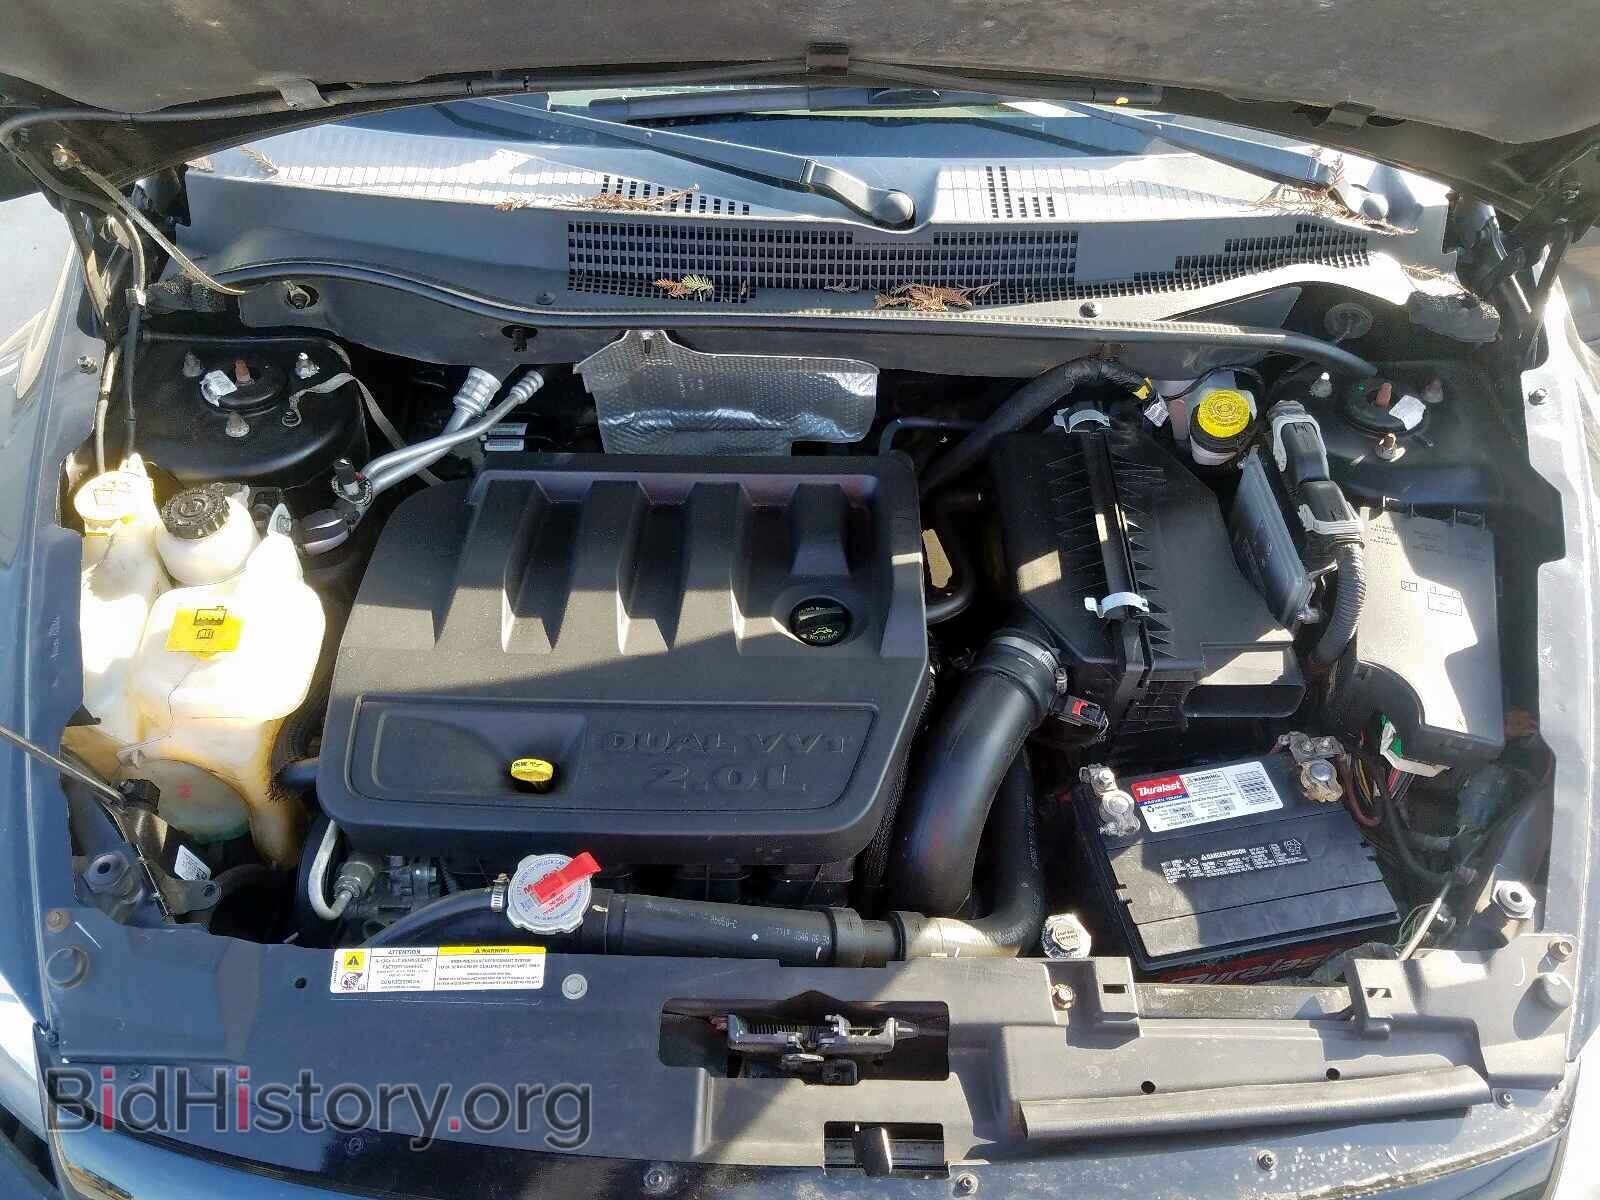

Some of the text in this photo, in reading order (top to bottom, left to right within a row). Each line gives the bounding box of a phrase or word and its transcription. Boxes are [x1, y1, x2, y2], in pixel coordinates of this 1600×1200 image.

[603, 731, 737, 752] DUAL
[647, 763, 808, 793] 2.0L
[1136, 781, 1182, 796] Duralast
